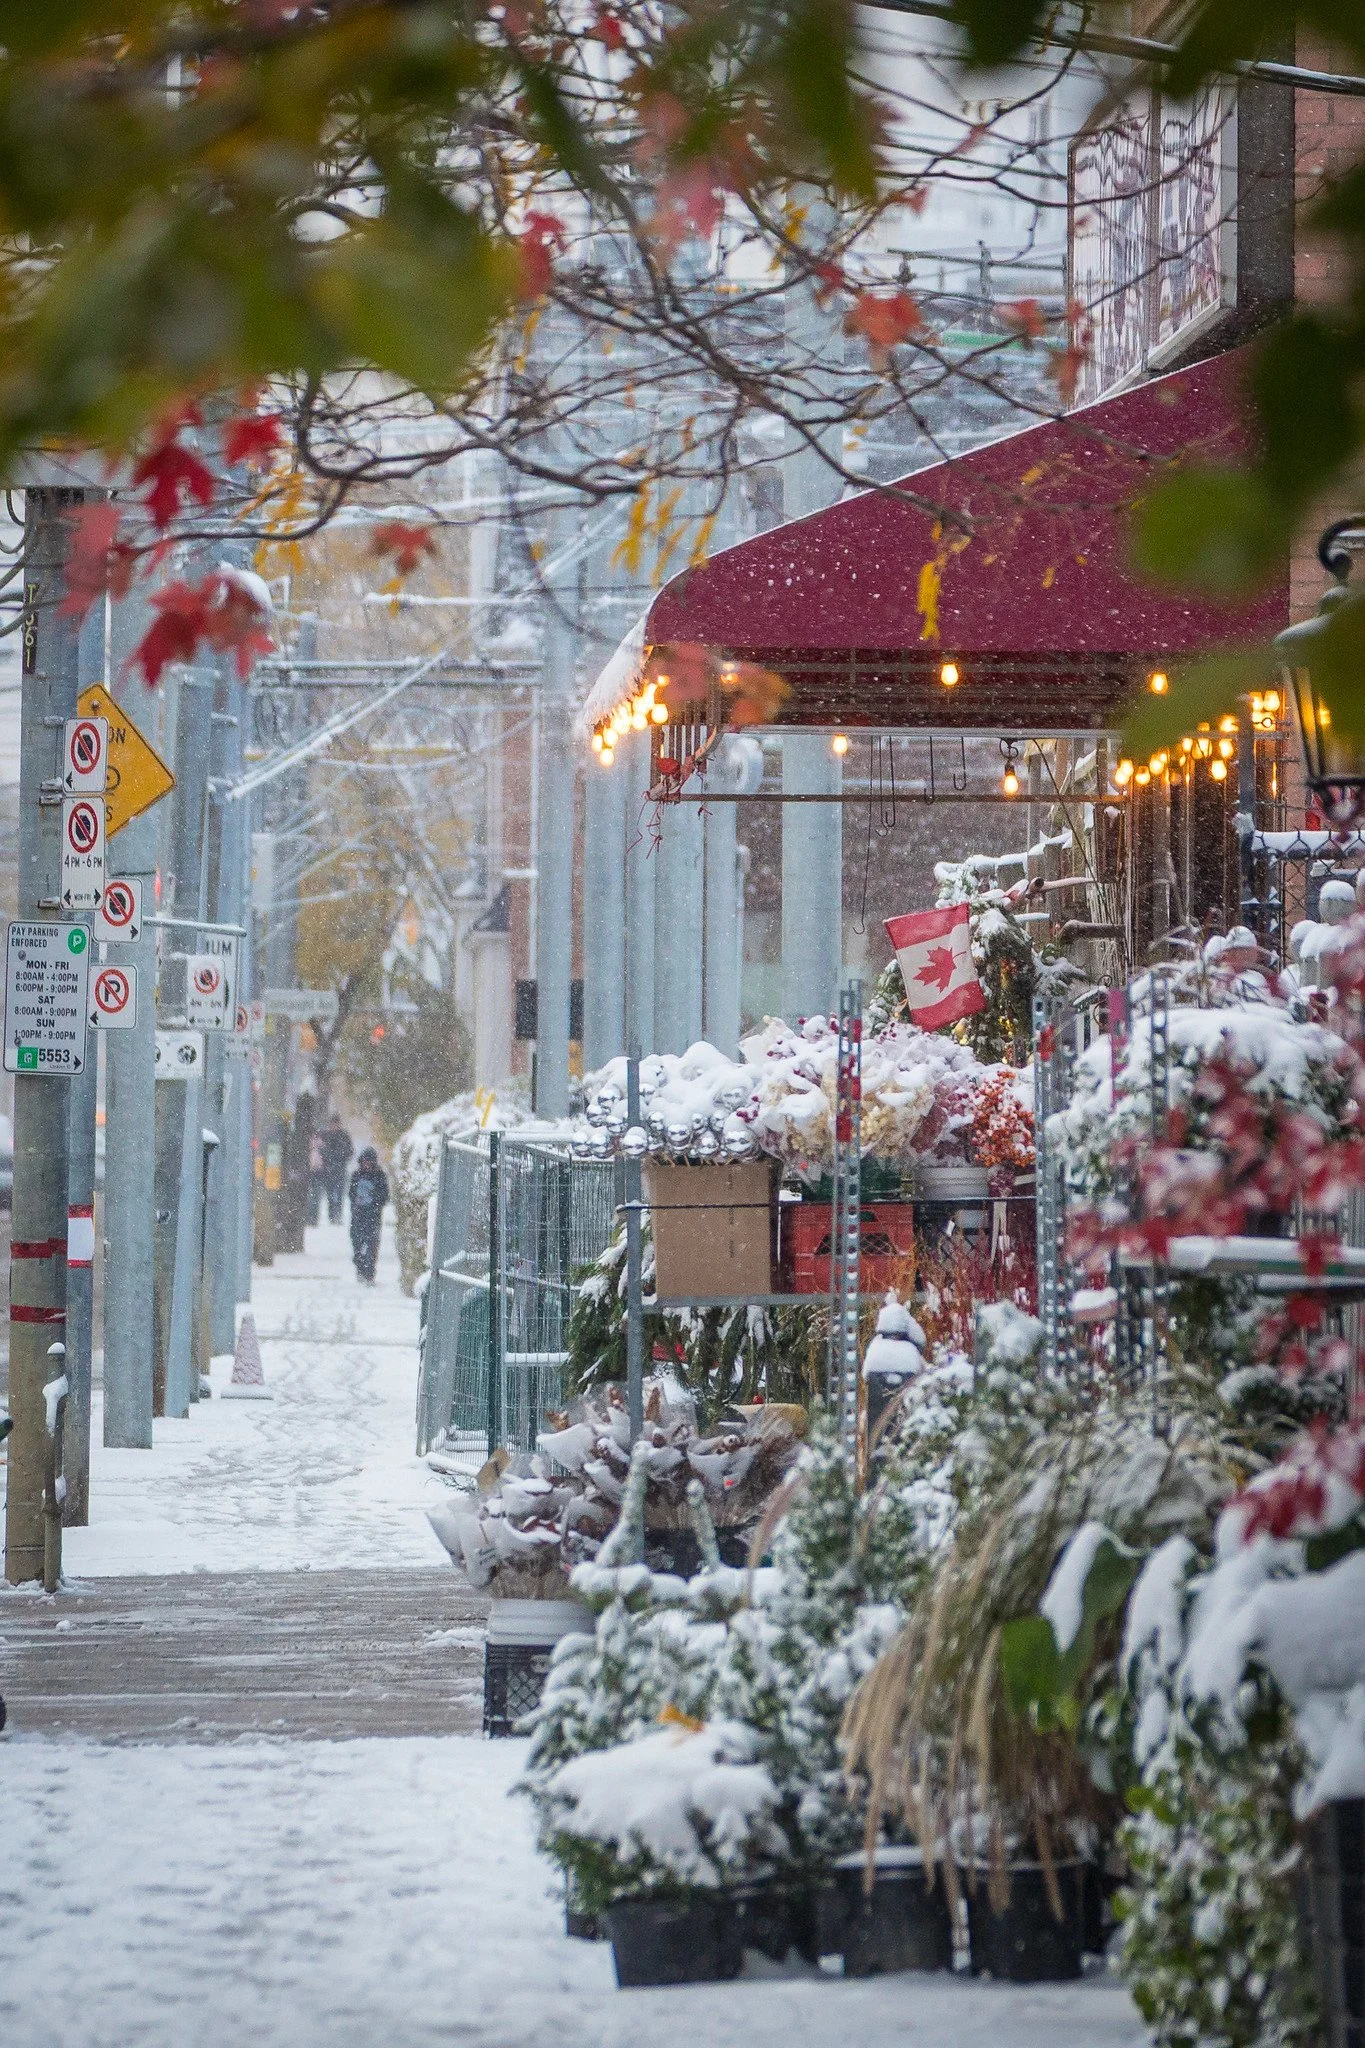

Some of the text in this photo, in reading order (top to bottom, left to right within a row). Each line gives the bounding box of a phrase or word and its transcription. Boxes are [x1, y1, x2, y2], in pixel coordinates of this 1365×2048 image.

[11, 926, 59, 937] PAY PARKING
[11, 938, 48, 948] ENFORCED
[26, 960, 47, 970] MON
[55, 961, 69, 971] FRI
[15, 971, 45, 981] 8:00AM
[51, 973, 79, 982] 4:00PM
[15, 983, 44, 992] 6:00PM
[50, 984, 78, 994] 9:00PM
[38, 995, 56, 1005] SAT
[14, 1006, 43, 1016] 8:00AM
[49, 1007, 77, 1017] 9:00PM
[36, 1018, 55, 1028] SUN
[14, 1029, 42, 1039] 1:00PM
[48, 1030, 76, 1040] 9:00PM
[38, 1048, 70, 1063] 5553
